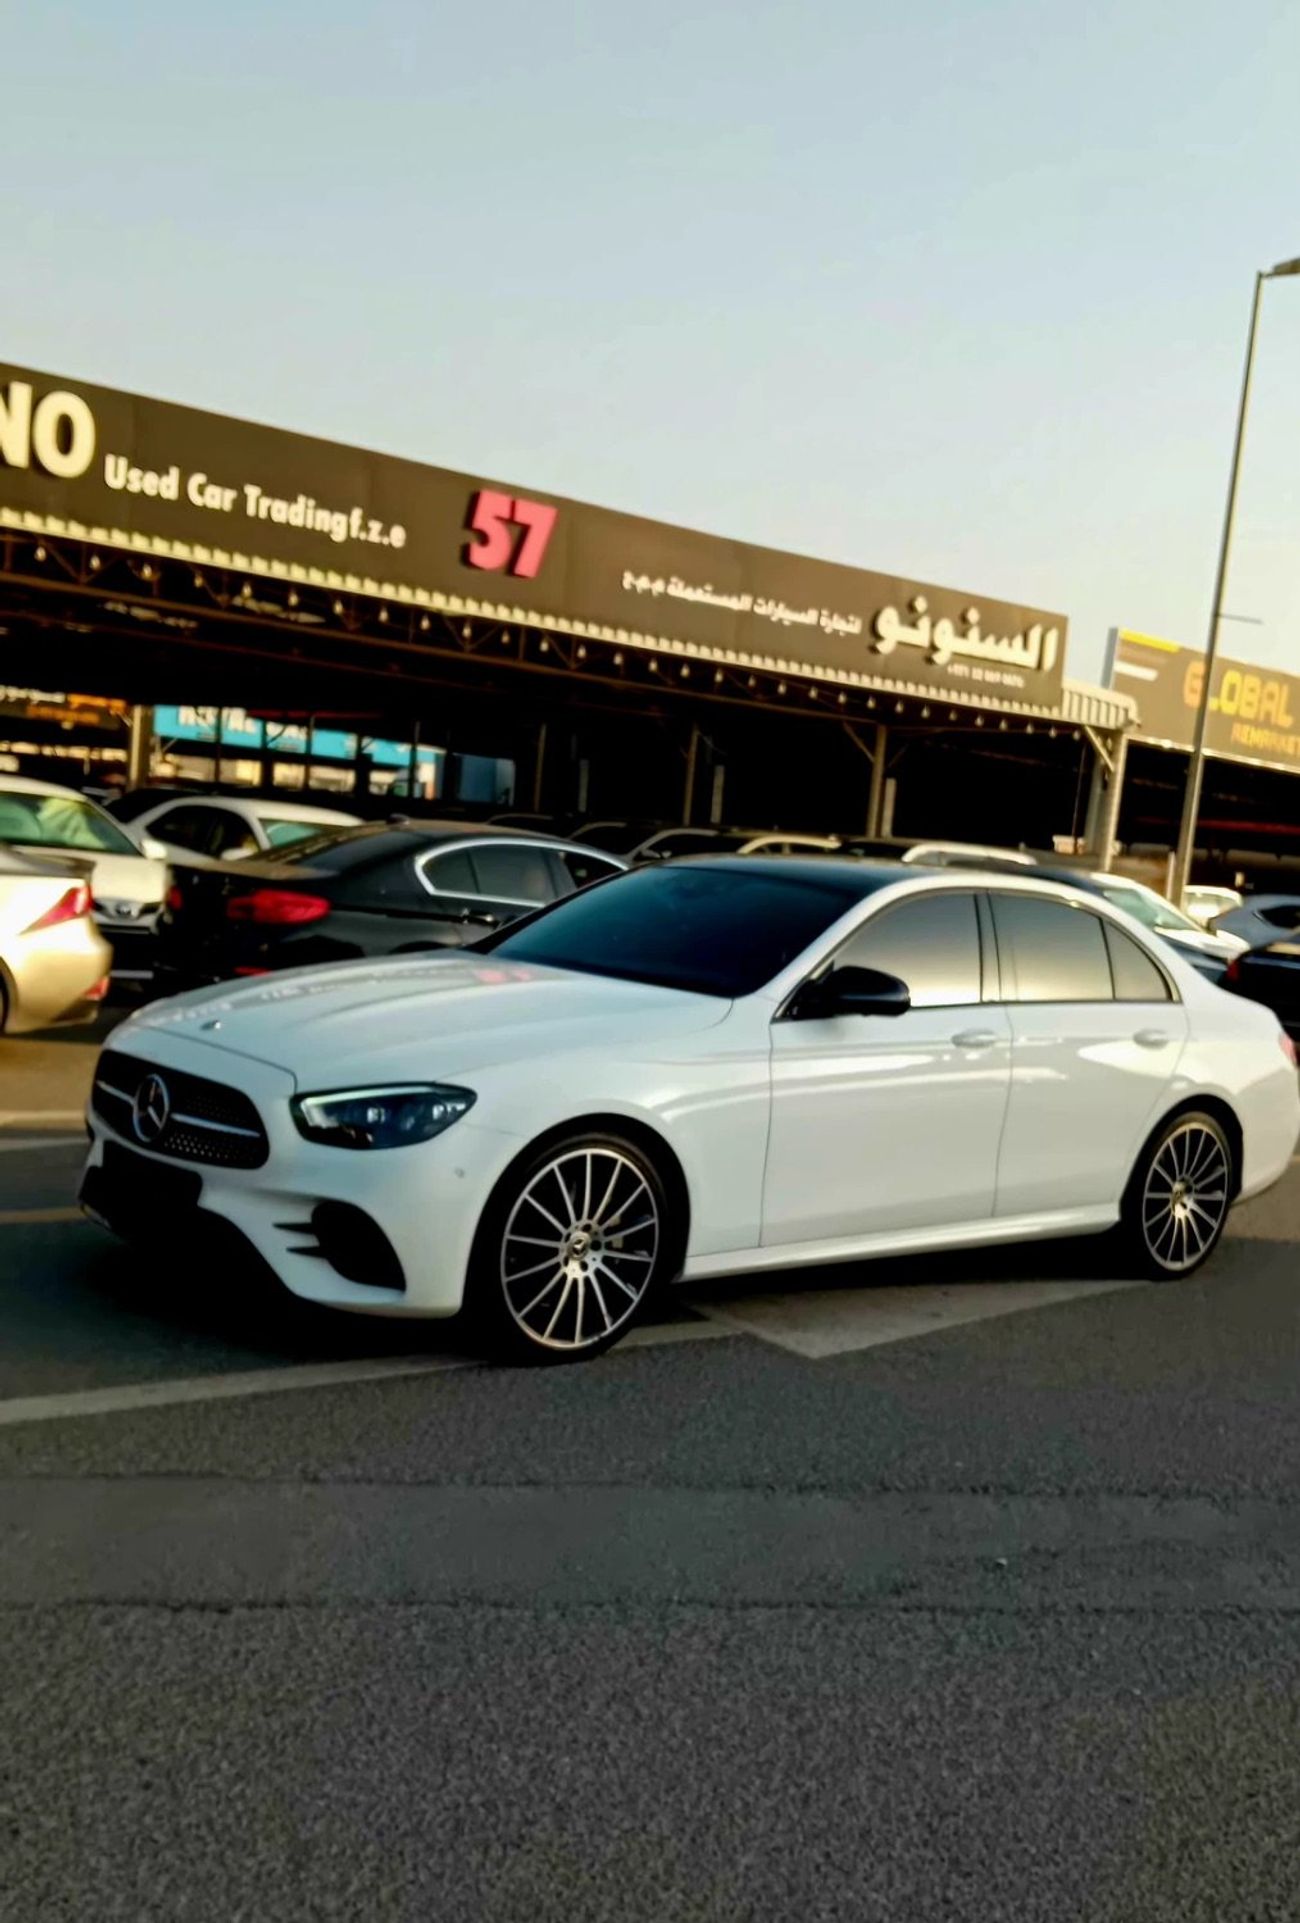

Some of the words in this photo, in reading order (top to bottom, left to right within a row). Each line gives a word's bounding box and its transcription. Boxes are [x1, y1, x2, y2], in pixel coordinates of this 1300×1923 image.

[104, 453, 180, 501] Used
[186, 472, 237, 512] Car
[462, 489, 558, 579] 57
[666, 575, 753, 612] المستعملة
[753, 597, 818, 626] السيارات
[875, 595, 1059, 672] السنونو
